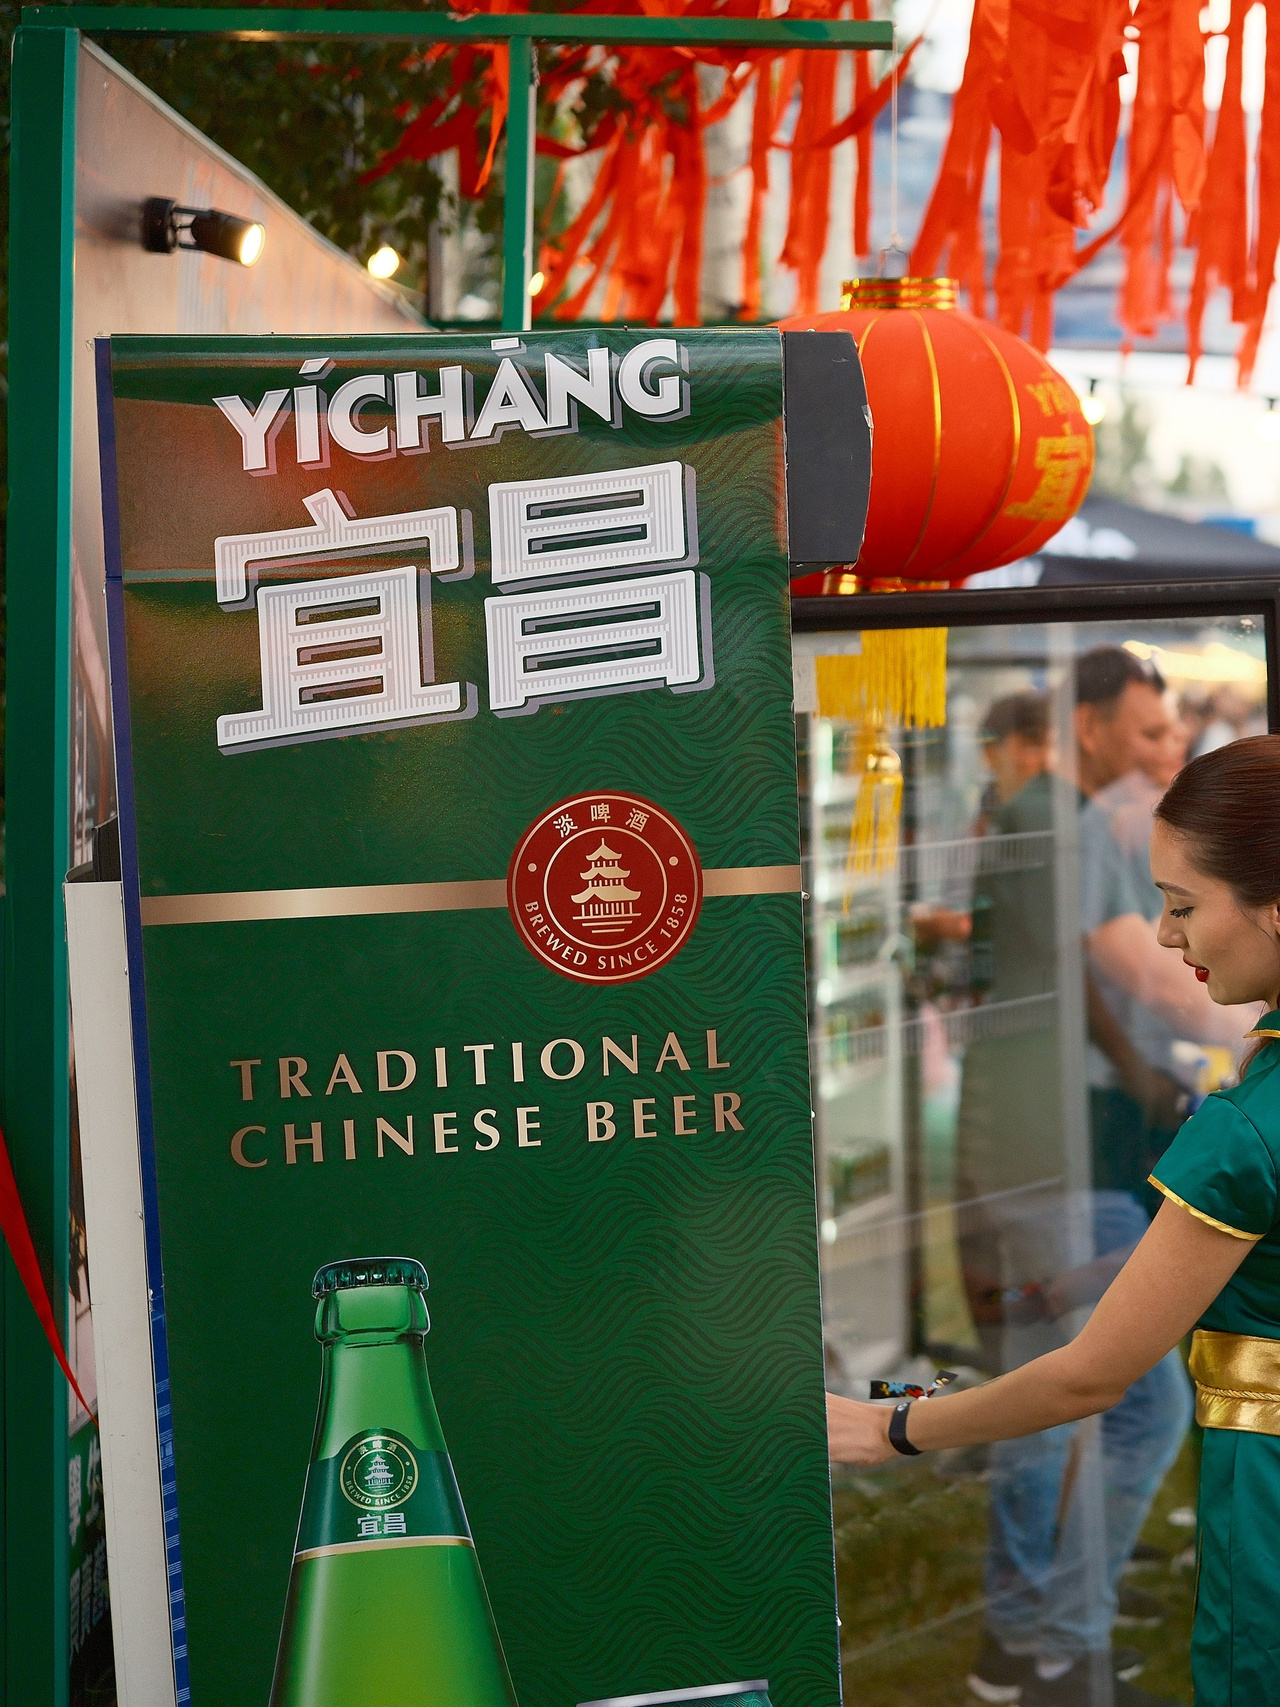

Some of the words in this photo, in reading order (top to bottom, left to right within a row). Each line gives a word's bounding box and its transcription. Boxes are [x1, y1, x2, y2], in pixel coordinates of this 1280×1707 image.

[212, 337, 690, 476] YÍCHĀNG
[214, 460, 715, 756] 宜昌
[552, 802, 650, 838] 淡啤酒
[524, 900, 588, 966] BREWED
[597, 939, 658, 970] SINCE
[659, 893, 688, 939] 1858
[229, 1028, 731, 1101] TRADITIONAL
[229, 1106, 542, 1168] CHINESE
[586, 1091, 746, 1142] BEER
[345, 1480, 372, 1504] BREWED
[374, 1493, 401, 1506] SINCE
[357, 1512, 407, 1538] 宜昌
